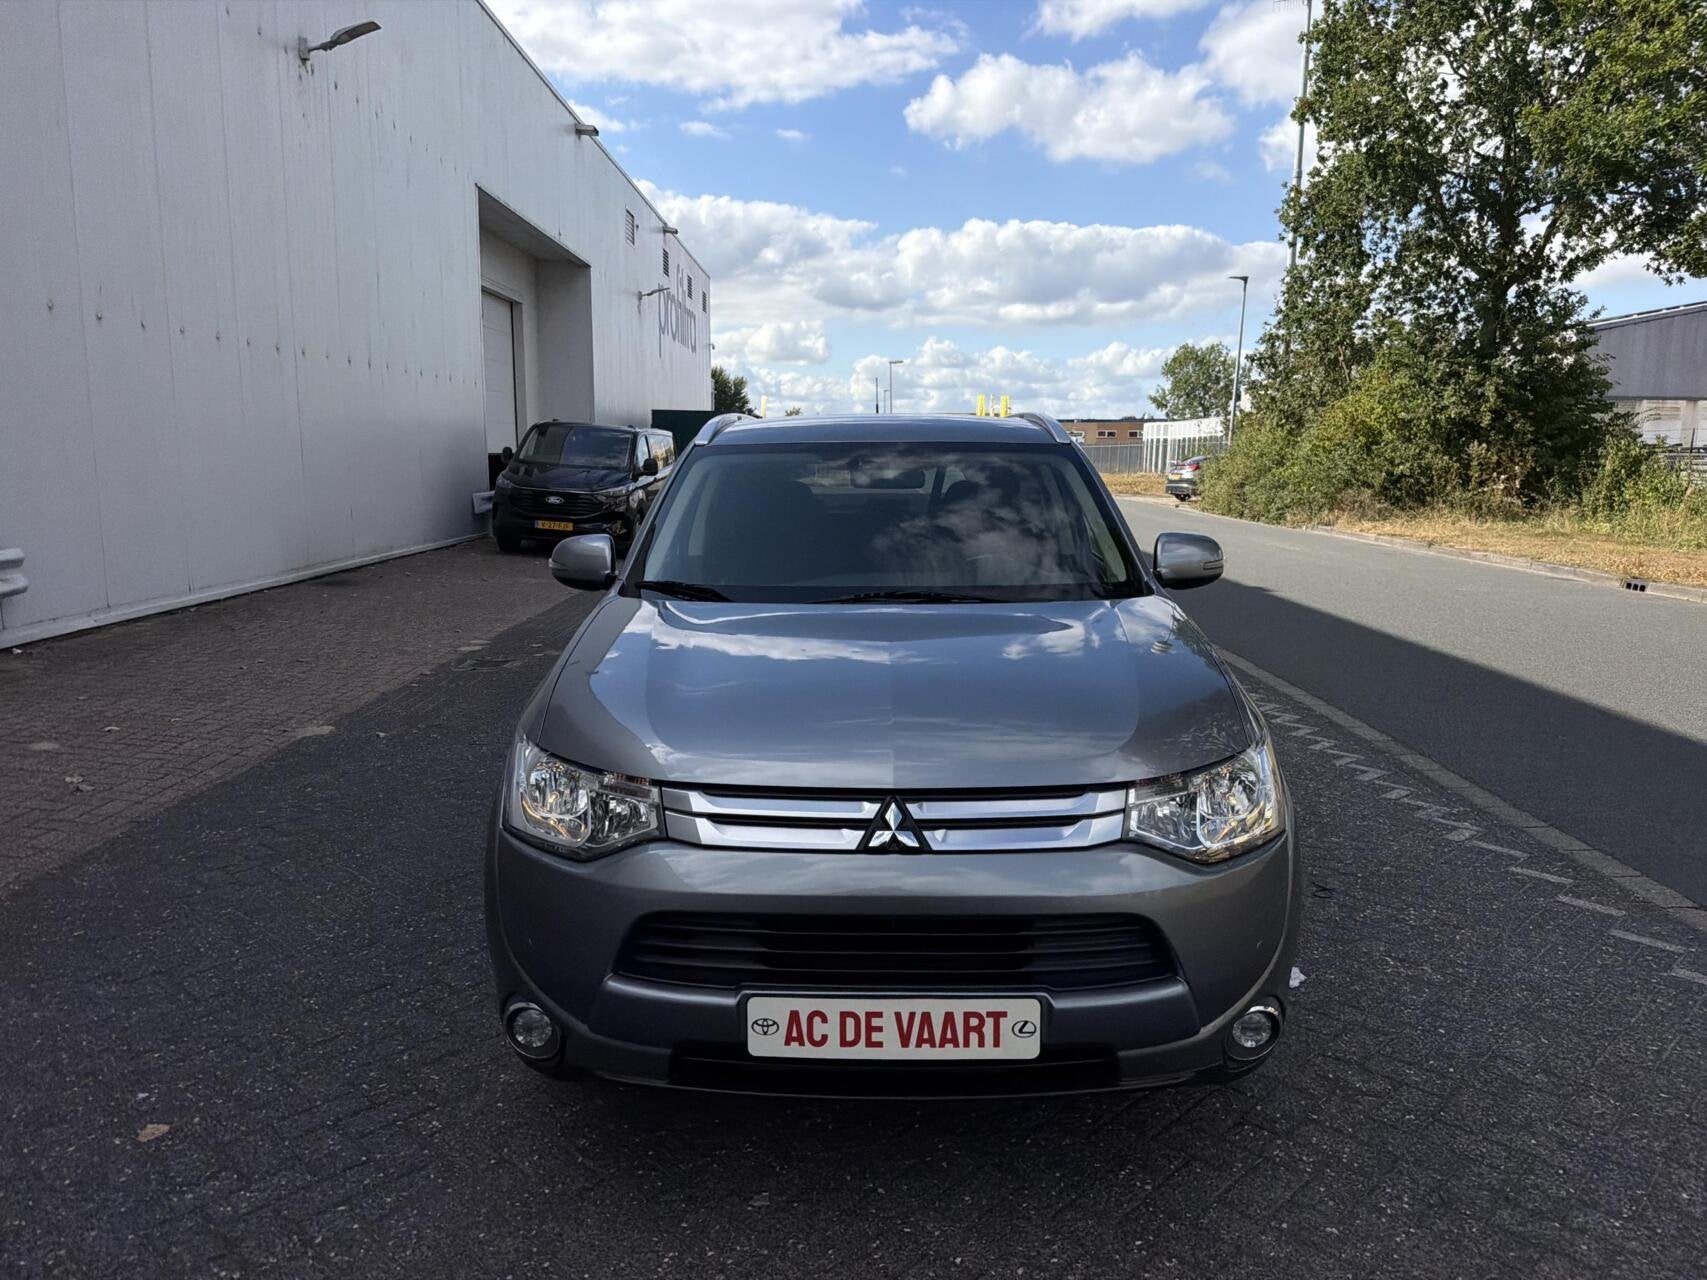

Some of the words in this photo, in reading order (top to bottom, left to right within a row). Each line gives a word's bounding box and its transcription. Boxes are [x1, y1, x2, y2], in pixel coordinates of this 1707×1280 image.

[784, 1010, 829, 1048] AC
[839, 1011, 884, 1048] DE
[894, 1011, 1008, 1048] VAART
